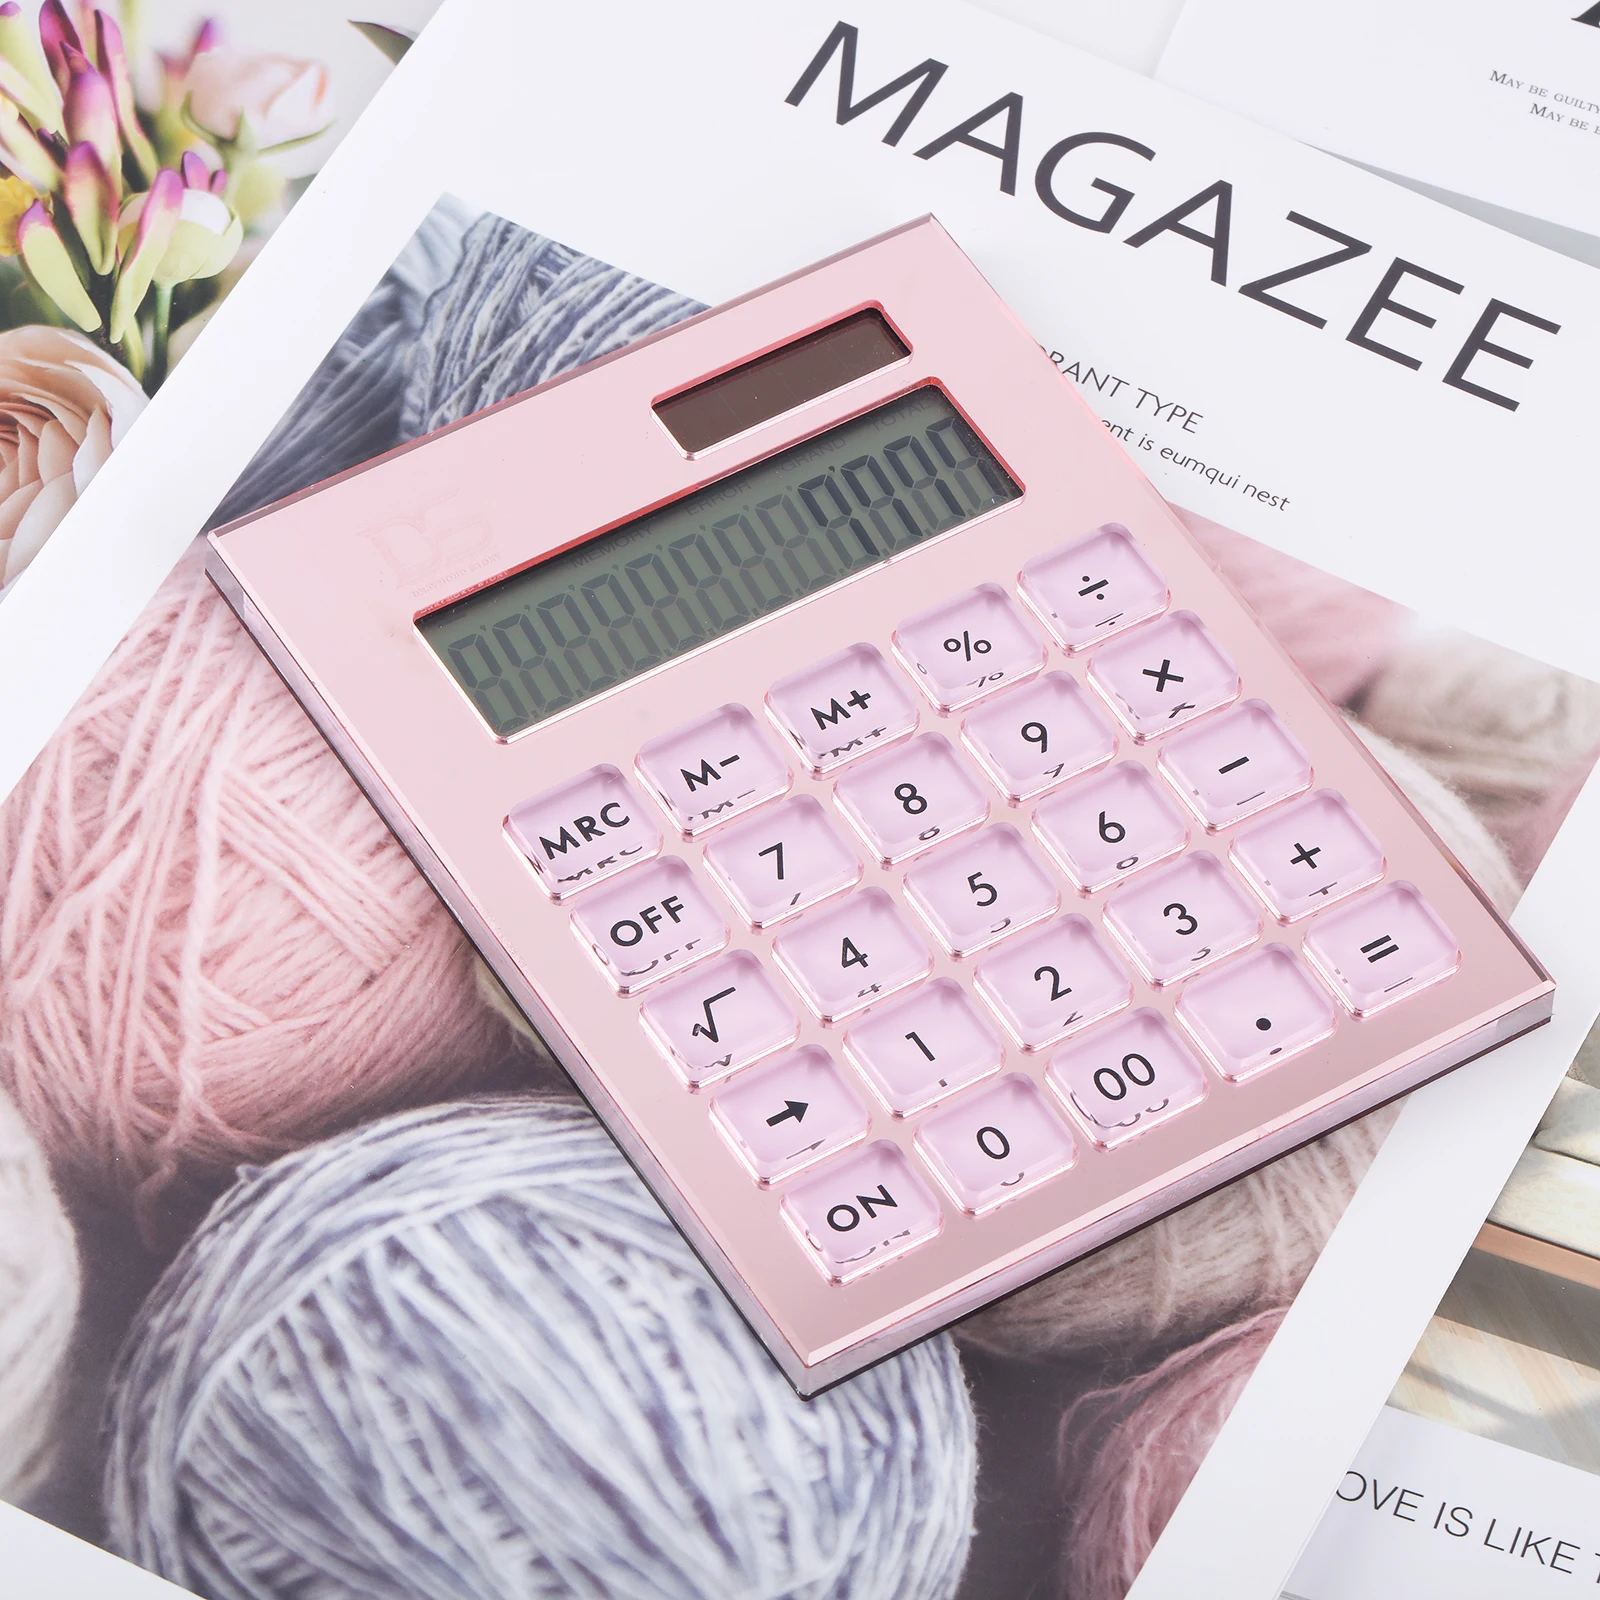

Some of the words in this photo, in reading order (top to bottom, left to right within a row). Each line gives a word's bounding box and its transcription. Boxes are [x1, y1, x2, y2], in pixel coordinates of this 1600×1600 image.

[784, 20, 1561, 412] MAGAZEE
[1040, 345, 1130, 397] RANT
[1136, 387, 1203, 434] TYPE
[1137, 433, 1155, 451] is
[1159, 447, 1241, 489] eumqui
[1242, 483, 1291, 512] nest
[943, 630, 992, 662] %
[810, 689, 872, 731] M+
[1021, 722, 1048, 754] 9
[680, 754, 740, 792] M-
[894, 783, 928, 815] 8
[538, 802, 631, 860] MRC
[1098, 811, 1126, 844] 6
[758, 842, 784, 880] 7
[967, 871, 998, 907] 5
[610, 895, 684, 947] OFF
[1163, 903, 1198, 936] 3
[841, 936, 869, 969] 4
[1034, 965, 1073, 1002] 2
[904, 1031, 936, 1062] 1
[1093, 1053, 1155, 1101] 00
[976, 1126, 1010, 1160] 0
[826, 1184, 898, 1232] ON
[1433, 1502, 1473, 1537] IS
[1483, 1518, 1581, 1574] LIKE
